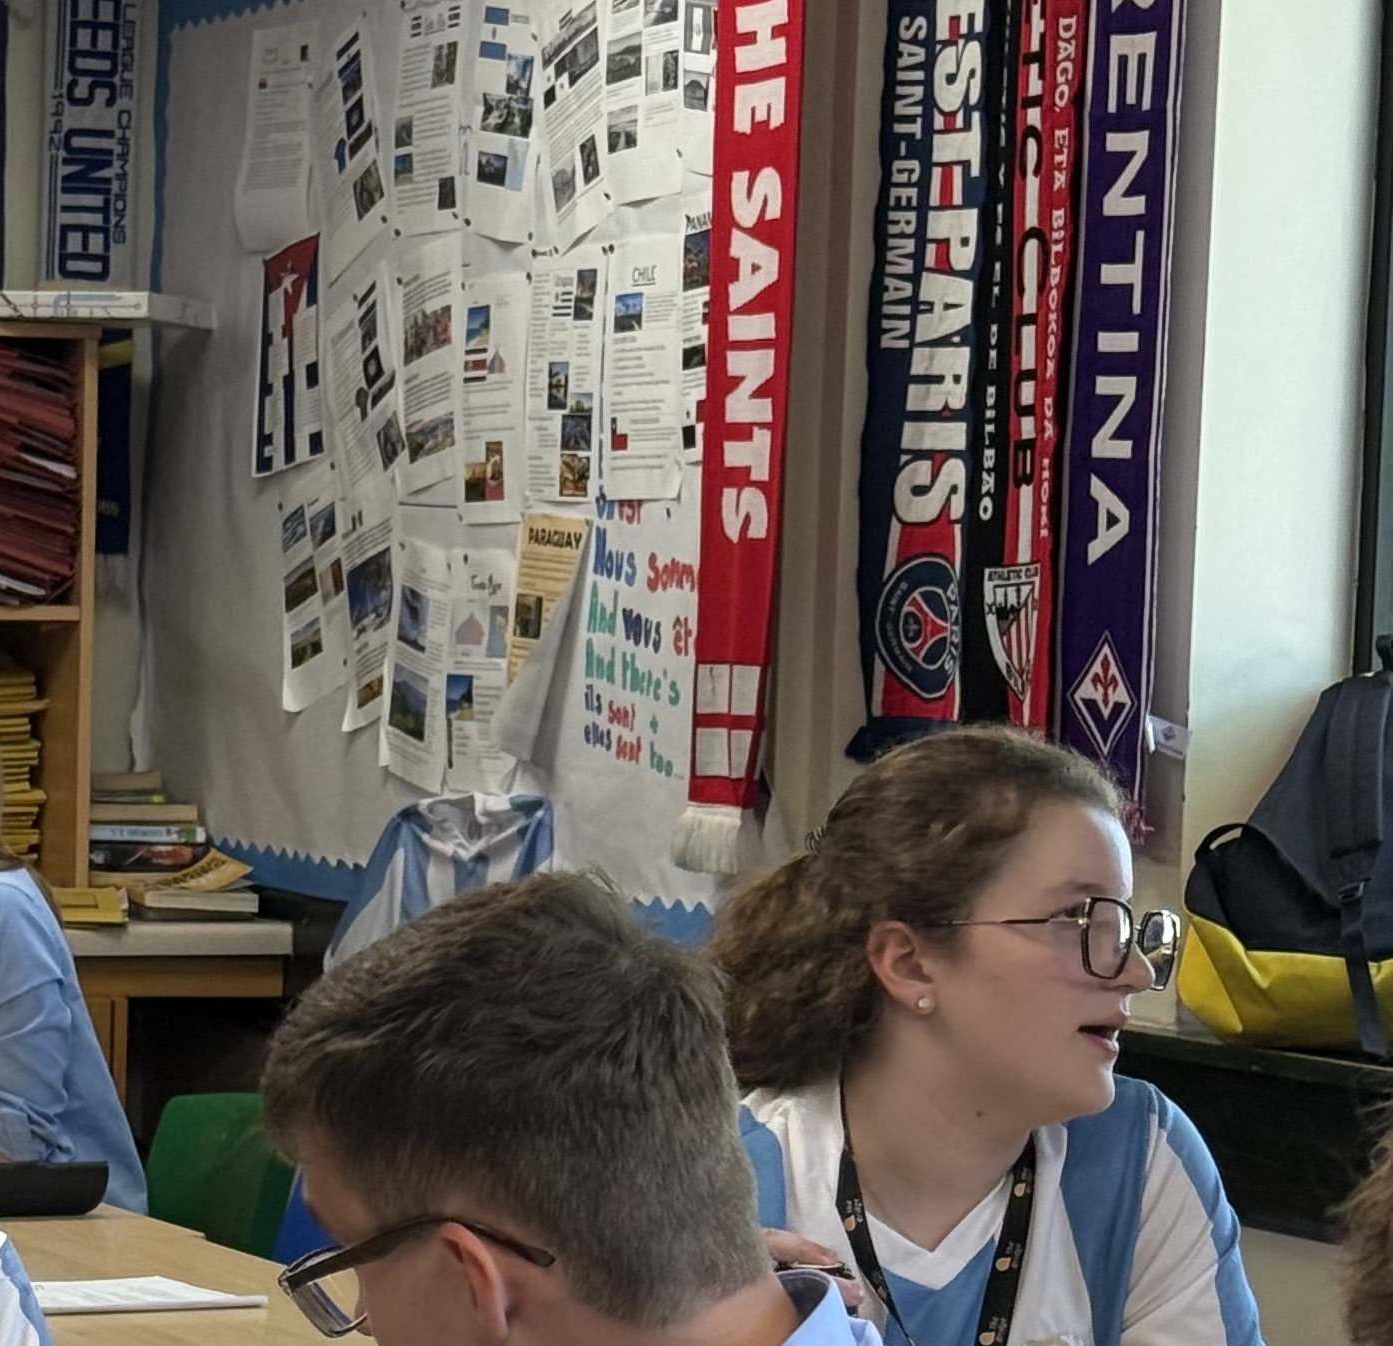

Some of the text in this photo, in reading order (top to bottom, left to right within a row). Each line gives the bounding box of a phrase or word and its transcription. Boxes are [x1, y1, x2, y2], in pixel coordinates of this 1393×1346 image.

[48, 93, 65, 152] 1992
[113, 3, 138, 245] LEAGUE CHAMPIONS
[880, 16, 928, 350] SAINT-GERMAIN
[1053, 128, 1069, 193] ETA
[58, 128, 116, 282] UNITED
[721, 166, 783, 544] SAINTS
[893, 208, 979, 524] PARIS
[1013, 227, 1049, 488] CLUB
[1042, 397, 1055, 441] DA
[527, 526, 583, 550] PARAGUAY
[593, 525, 637, 587] Nous
[587, 580, 618, 636] And
[585, 638, 616, 684] And
[584, 684, 603, 716] ils
[584, 721, 612, 752] elles
